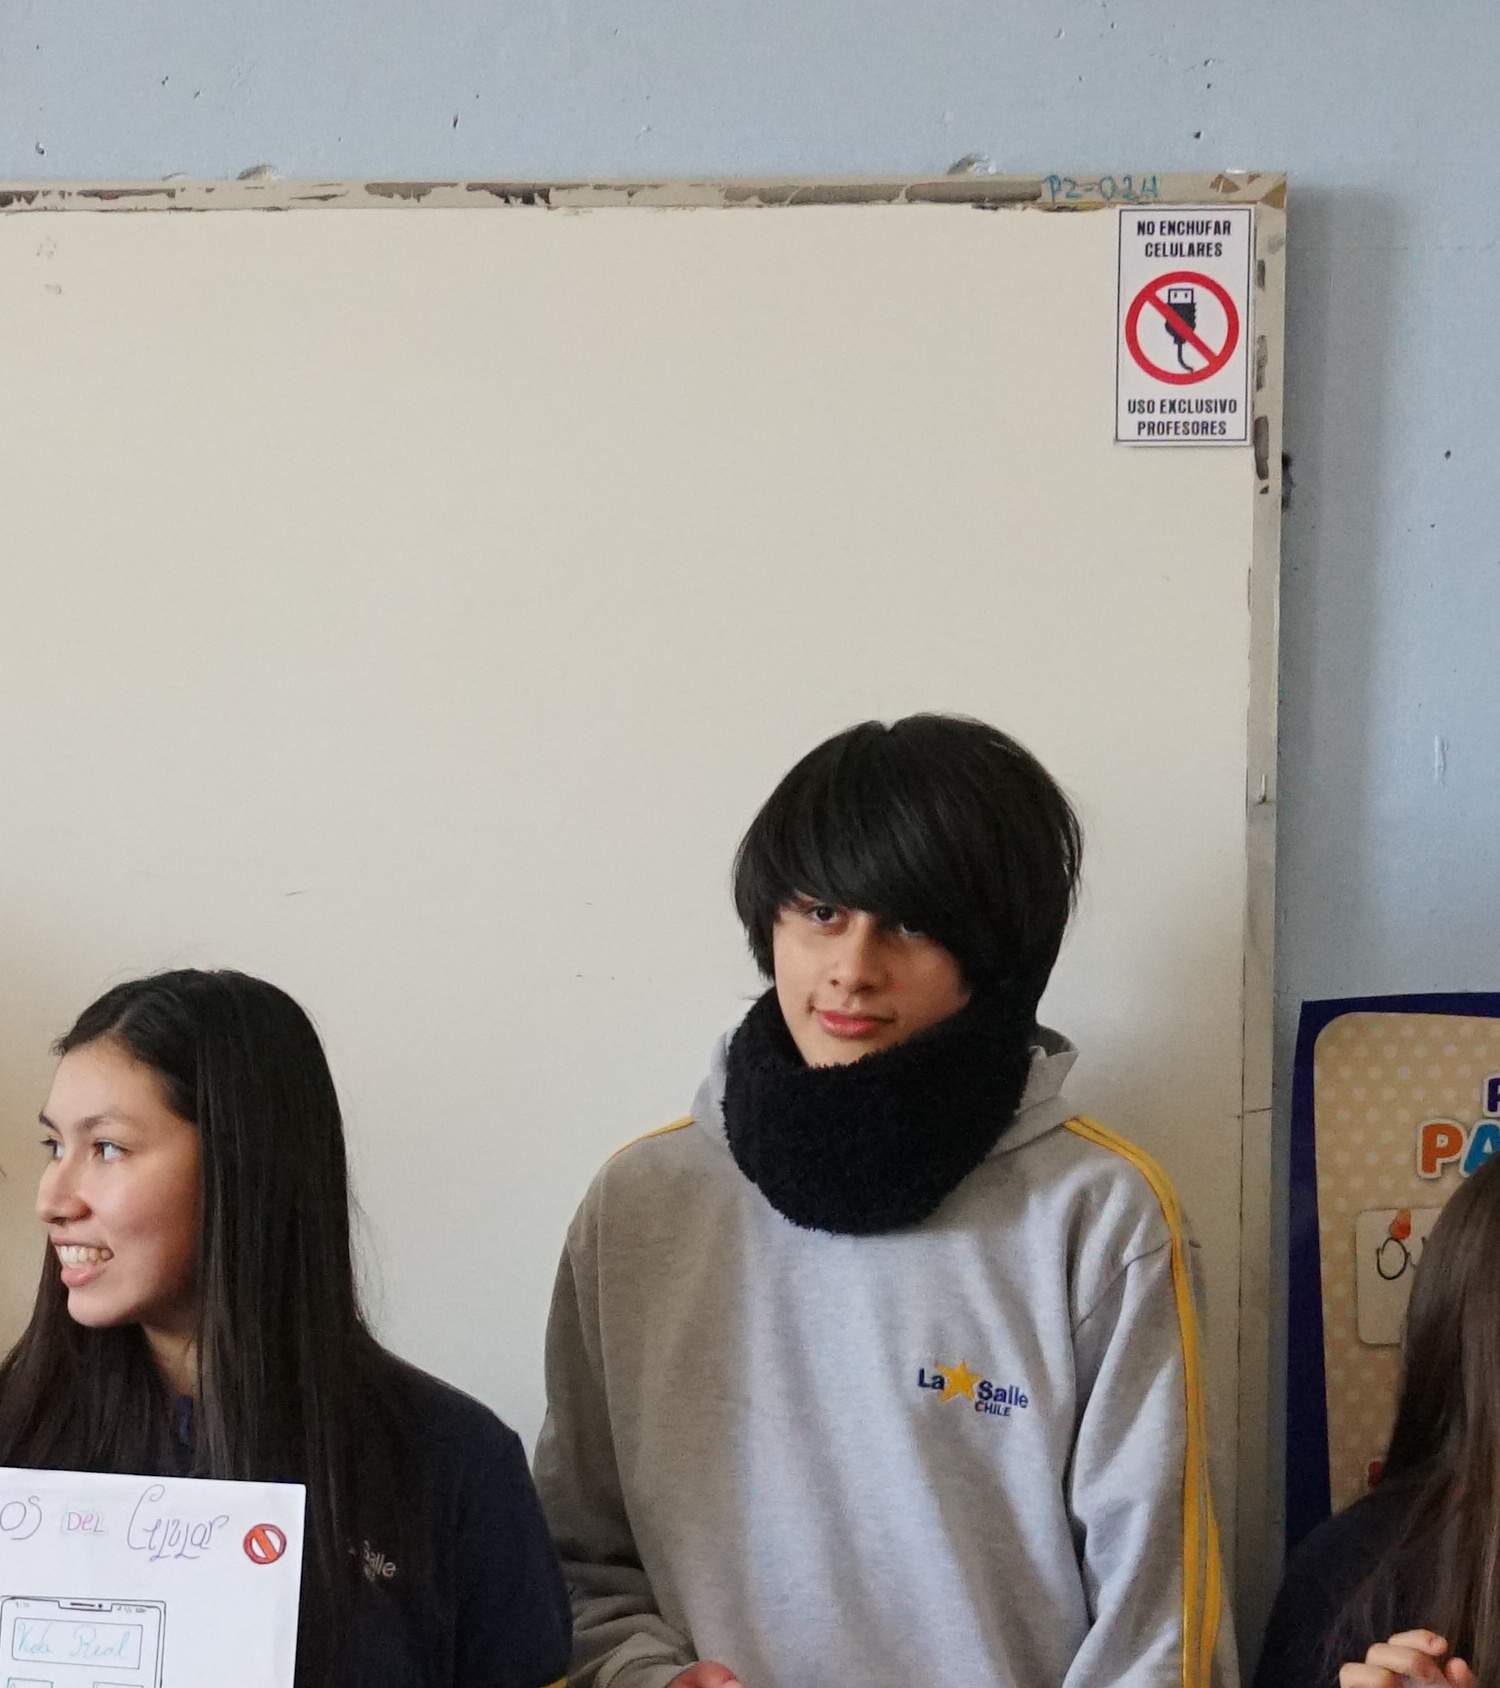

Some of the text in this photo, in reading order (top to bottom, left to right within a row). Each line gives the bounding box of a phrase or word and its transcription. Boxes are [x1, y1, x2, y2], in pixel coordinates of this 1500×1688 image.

[1137, 220, 1232, 236] NO ENCHUFAR
[1145, 242, 1223, 257] CELULARES
[1128, 399, 1238, 414] USO EXCLUSIVO
[1137, 421, 1227, 436] PROFESORES
[917, 1368, 1029, 1409] La Salle
[974, 1401, 1012, 1417] CHILE
